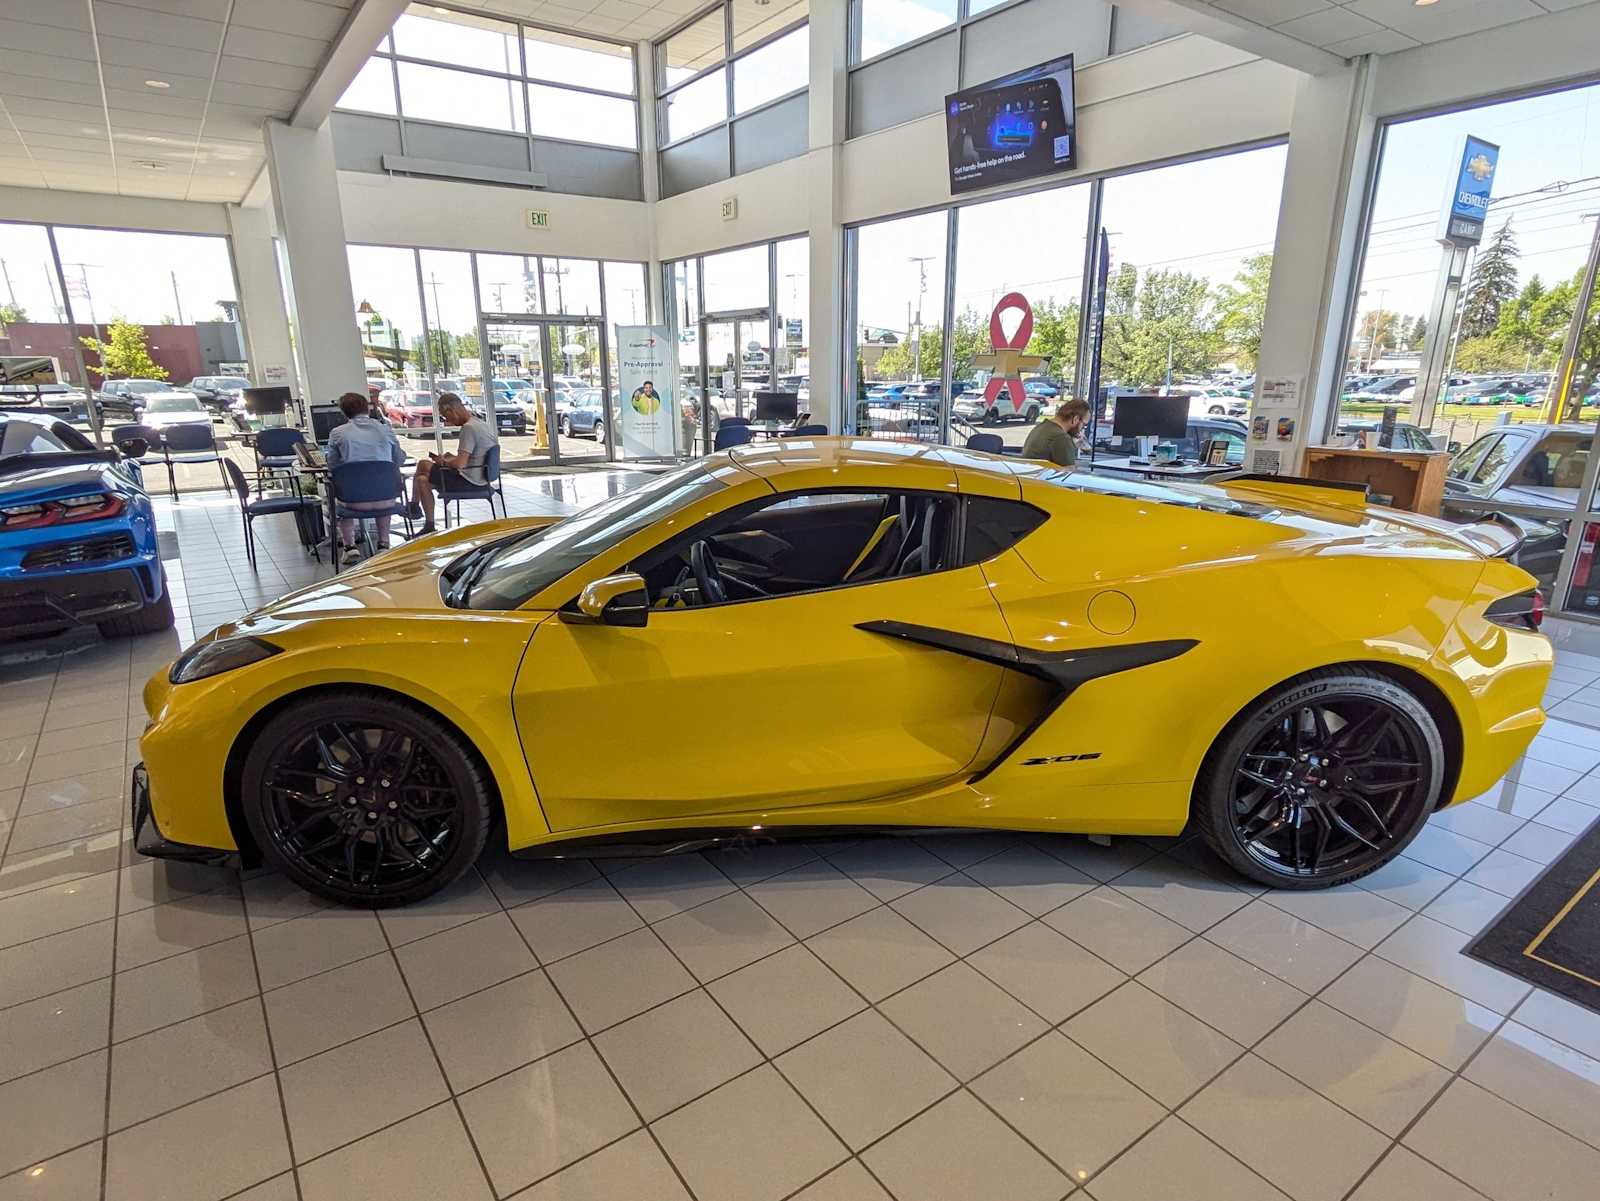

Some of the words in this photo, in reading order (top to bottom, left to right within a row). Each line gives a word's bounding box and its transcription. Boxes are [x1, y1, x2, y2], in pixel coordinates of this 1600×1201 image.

[954, 167, 963, 175] Get
[962, 160, 987, 173] hands-free
[986, 158, 997, 168] help
[1004, 154, 1013, 163] the
[1458, 192, 1489, 209] CHEVROLET
[722, 202, 732, 217] EXIT
[531, 212, 548, 226] EXIT
[623, 361, 664, 370] Pre-Approval
[1269, 683, 1328, 714] MICHELIN
